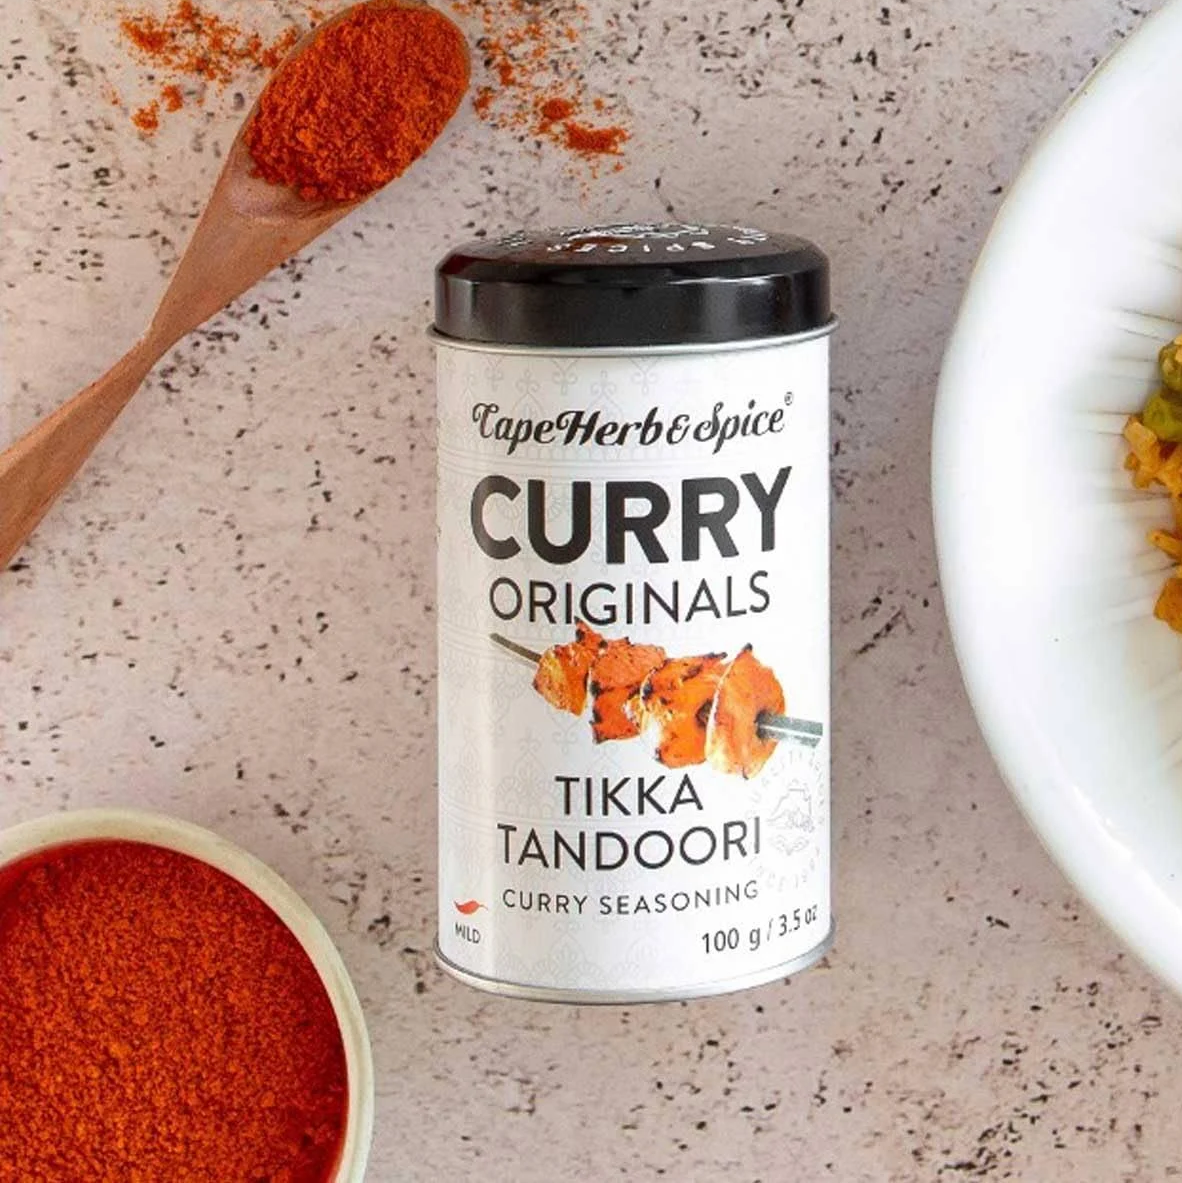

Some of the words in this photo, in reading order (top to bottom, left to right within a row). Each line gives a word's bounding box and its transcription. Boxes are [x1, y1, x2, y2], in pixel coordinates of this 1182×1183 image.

[469, 465, 793, 565] CURRY
[489, 570, 771, 625] ORIGINALS
[554, 773, 704, 817] TIKKA
[496, 816, 761, 872] TANDOORI
[502, 888, 588, 916] CURRY
[599, 879, 759, 916] SEASONING
[455, 922, 481, 944] MILD
[702, 927, 740, 954] 100
[749, 927, 761, 951] g
[779, 908, 801, 936] 3.5
[804, 904, 818, 925] oz
